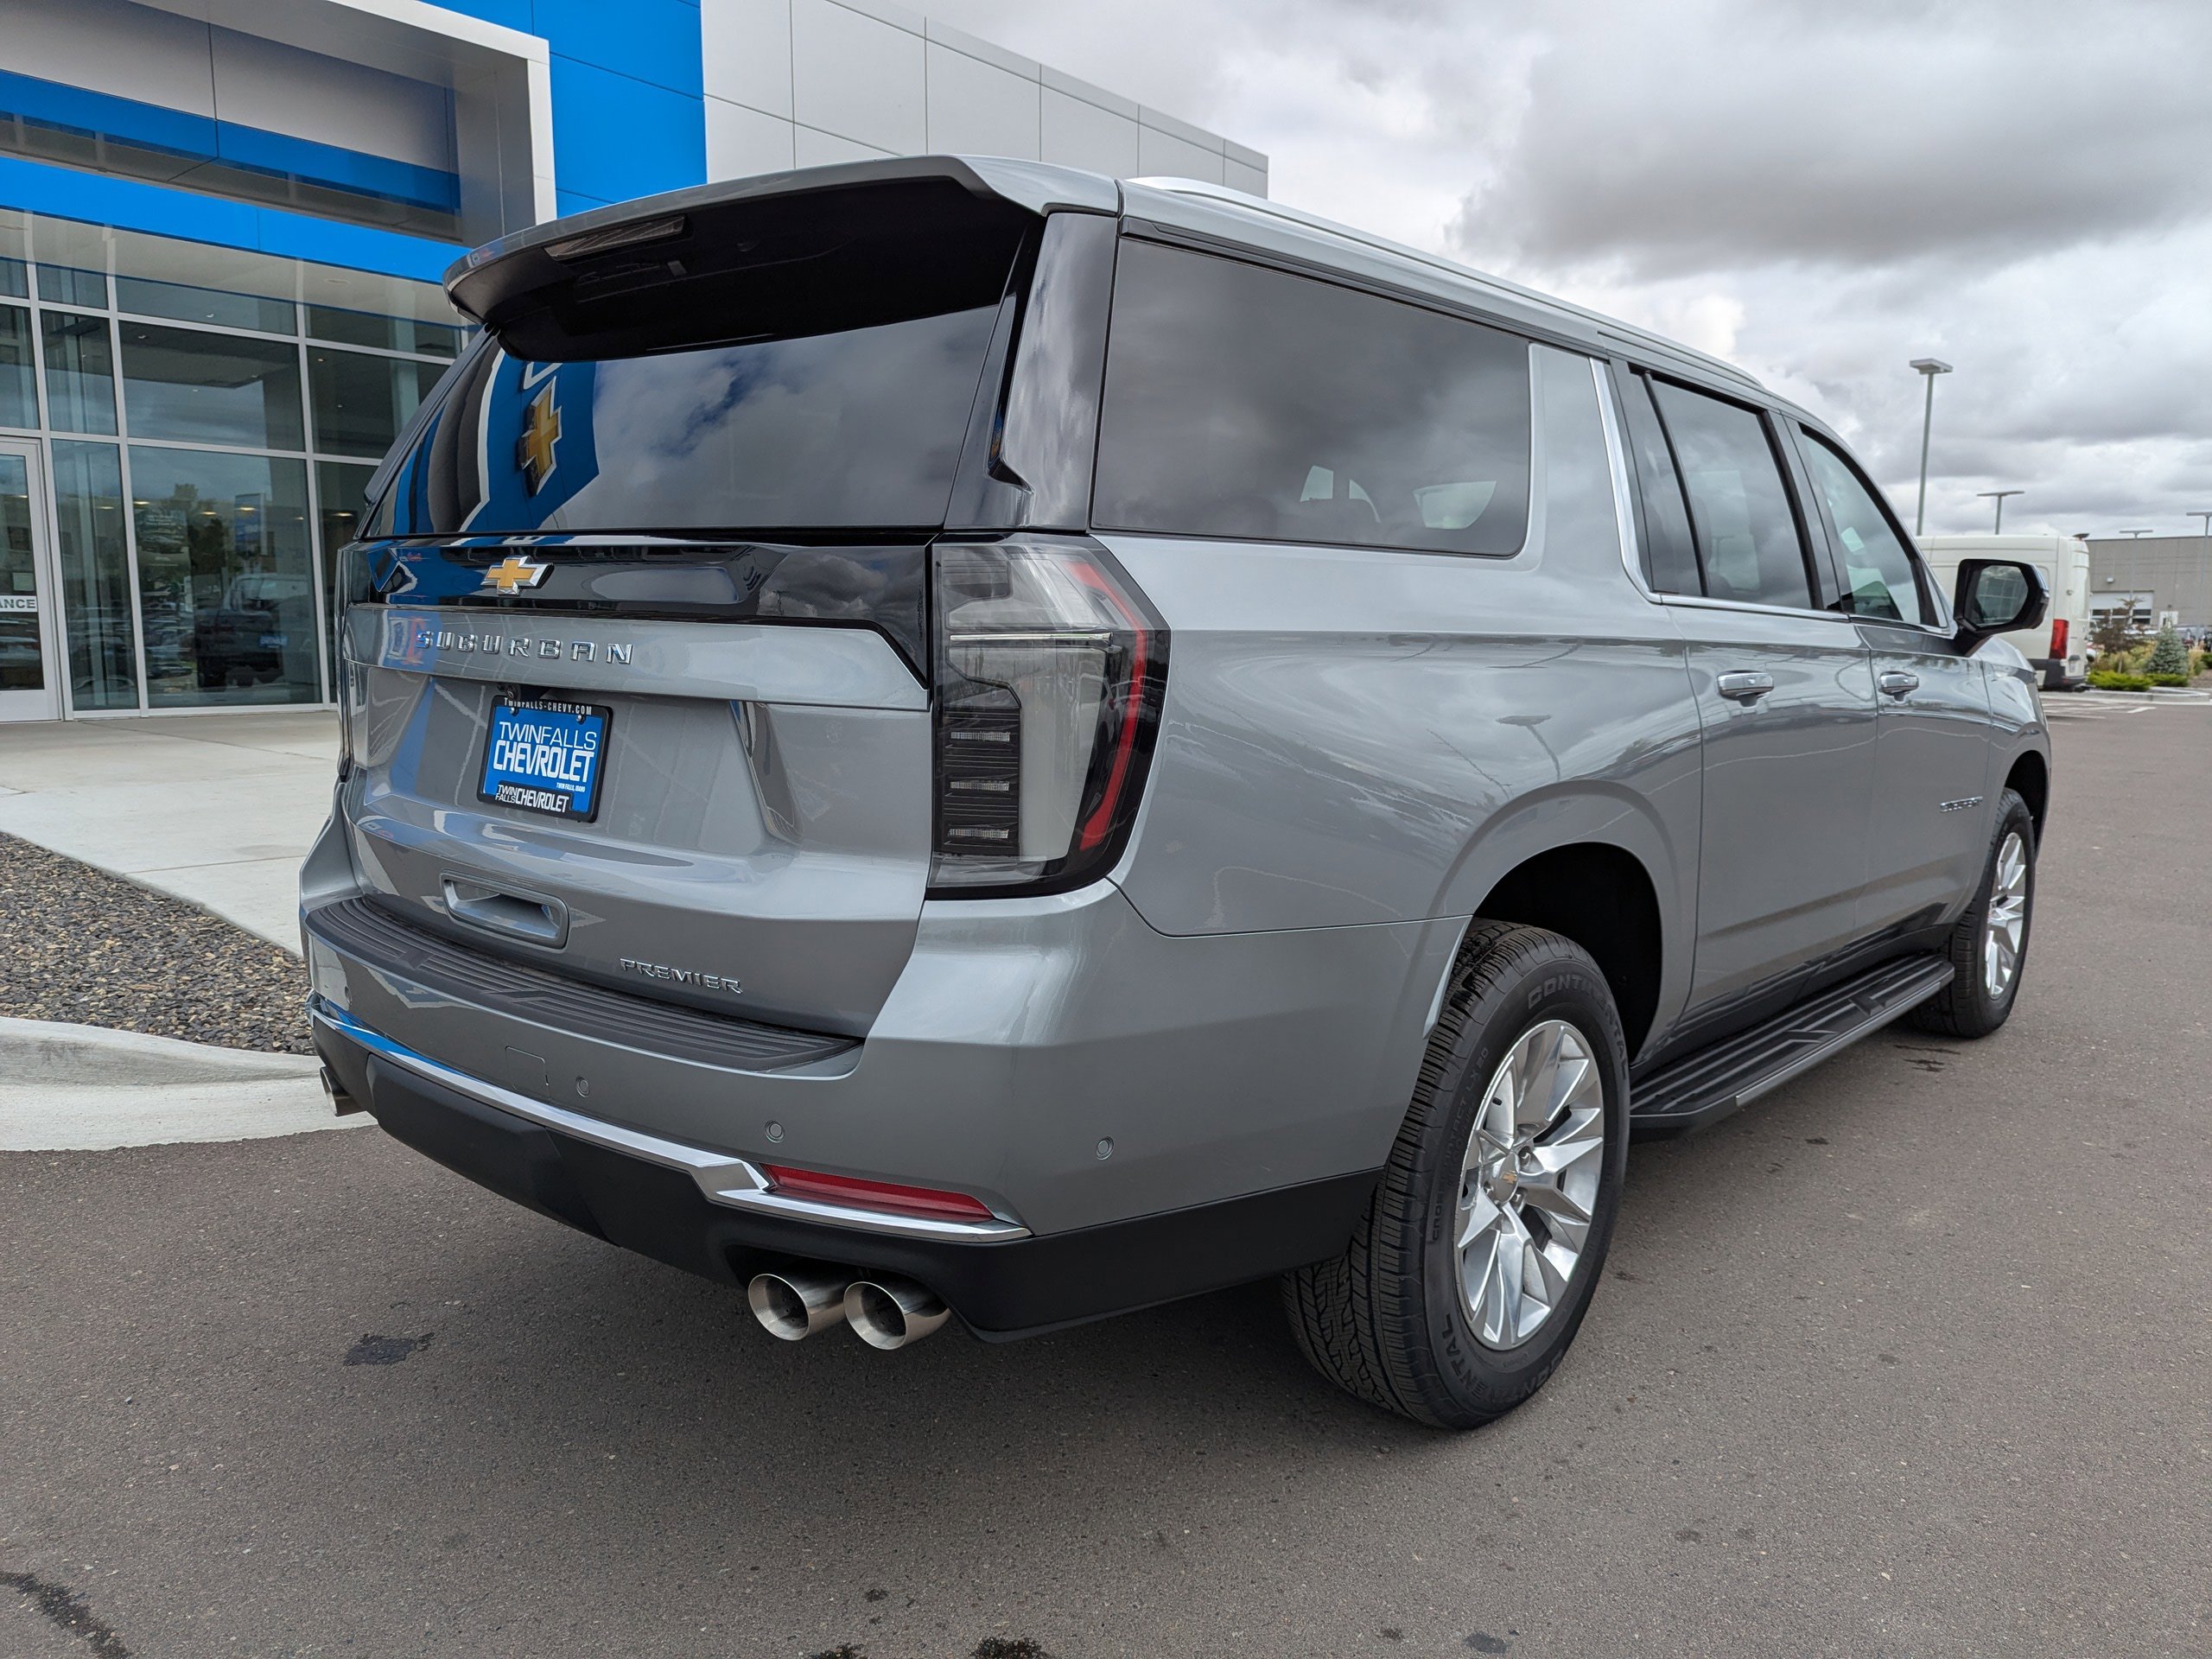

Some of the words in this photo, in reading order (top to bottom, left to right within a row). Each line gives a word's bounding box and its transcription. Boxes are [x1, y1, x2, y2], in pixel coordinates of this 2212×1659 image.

[415, 630, 635, 665] SUBURBAN
[499, 721, 597, 751] TWINFALLS
[493, 740, 594, 783] CHEVROLET
[494, 792, 517, 804] FALLS
[498, 785, 518, 796] TWIN
[515, 788, 569, 813] CHEVROLET
[620, 957, 743, 995] PREMIER
